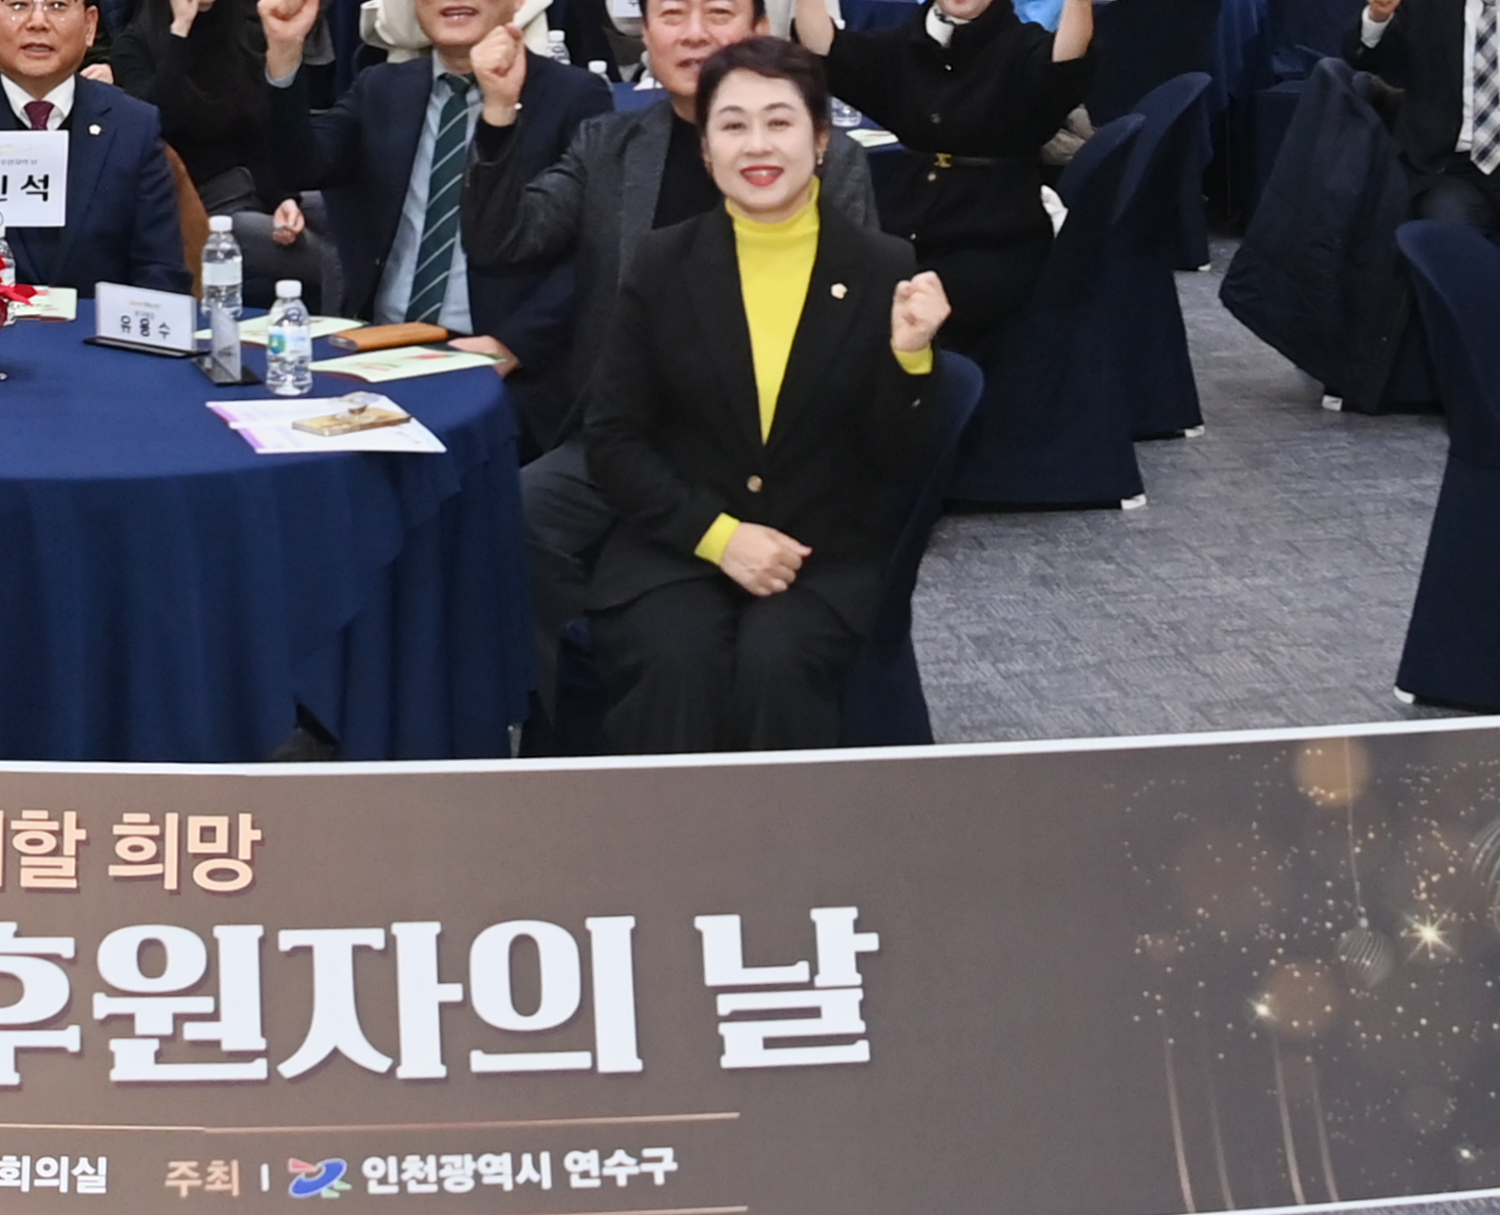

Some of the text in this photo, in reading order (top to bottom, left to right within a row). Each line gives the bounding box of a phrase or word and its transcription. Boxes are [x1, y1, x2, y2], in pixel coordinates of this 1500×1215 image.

[109, 810, 262, 893] 희망
[693, 906, 880, 1070] 날
[164, 1157, 241, 1198] 주최
[360, 1149, 554, 1195] 인천광역시
[563, 1146, 679, 1189] 연수구
